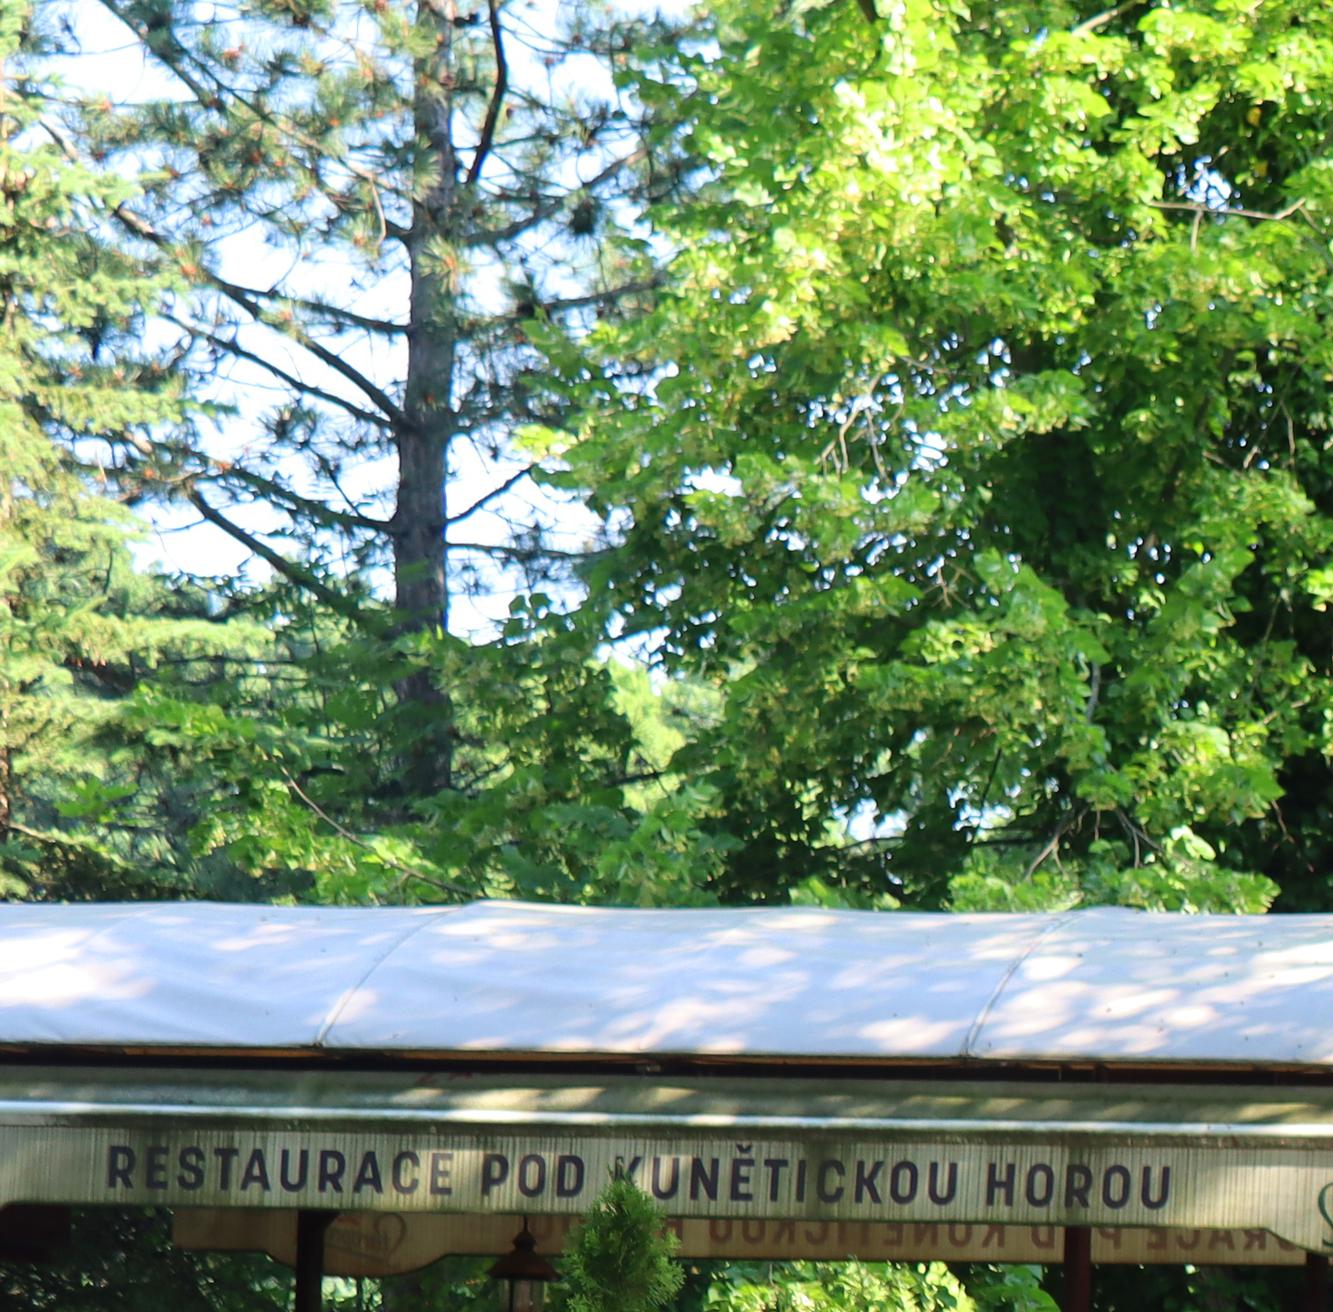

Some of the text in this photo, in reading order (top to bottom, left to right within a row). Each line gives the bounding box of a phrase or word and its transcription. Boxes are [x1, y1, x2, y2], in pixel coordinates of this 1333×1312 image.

[105, 1144, 454, 1197] RESTAURACE
[480, 1152, 586, 1200] POD
[985, 1161, 1172, 1211] HOROU
